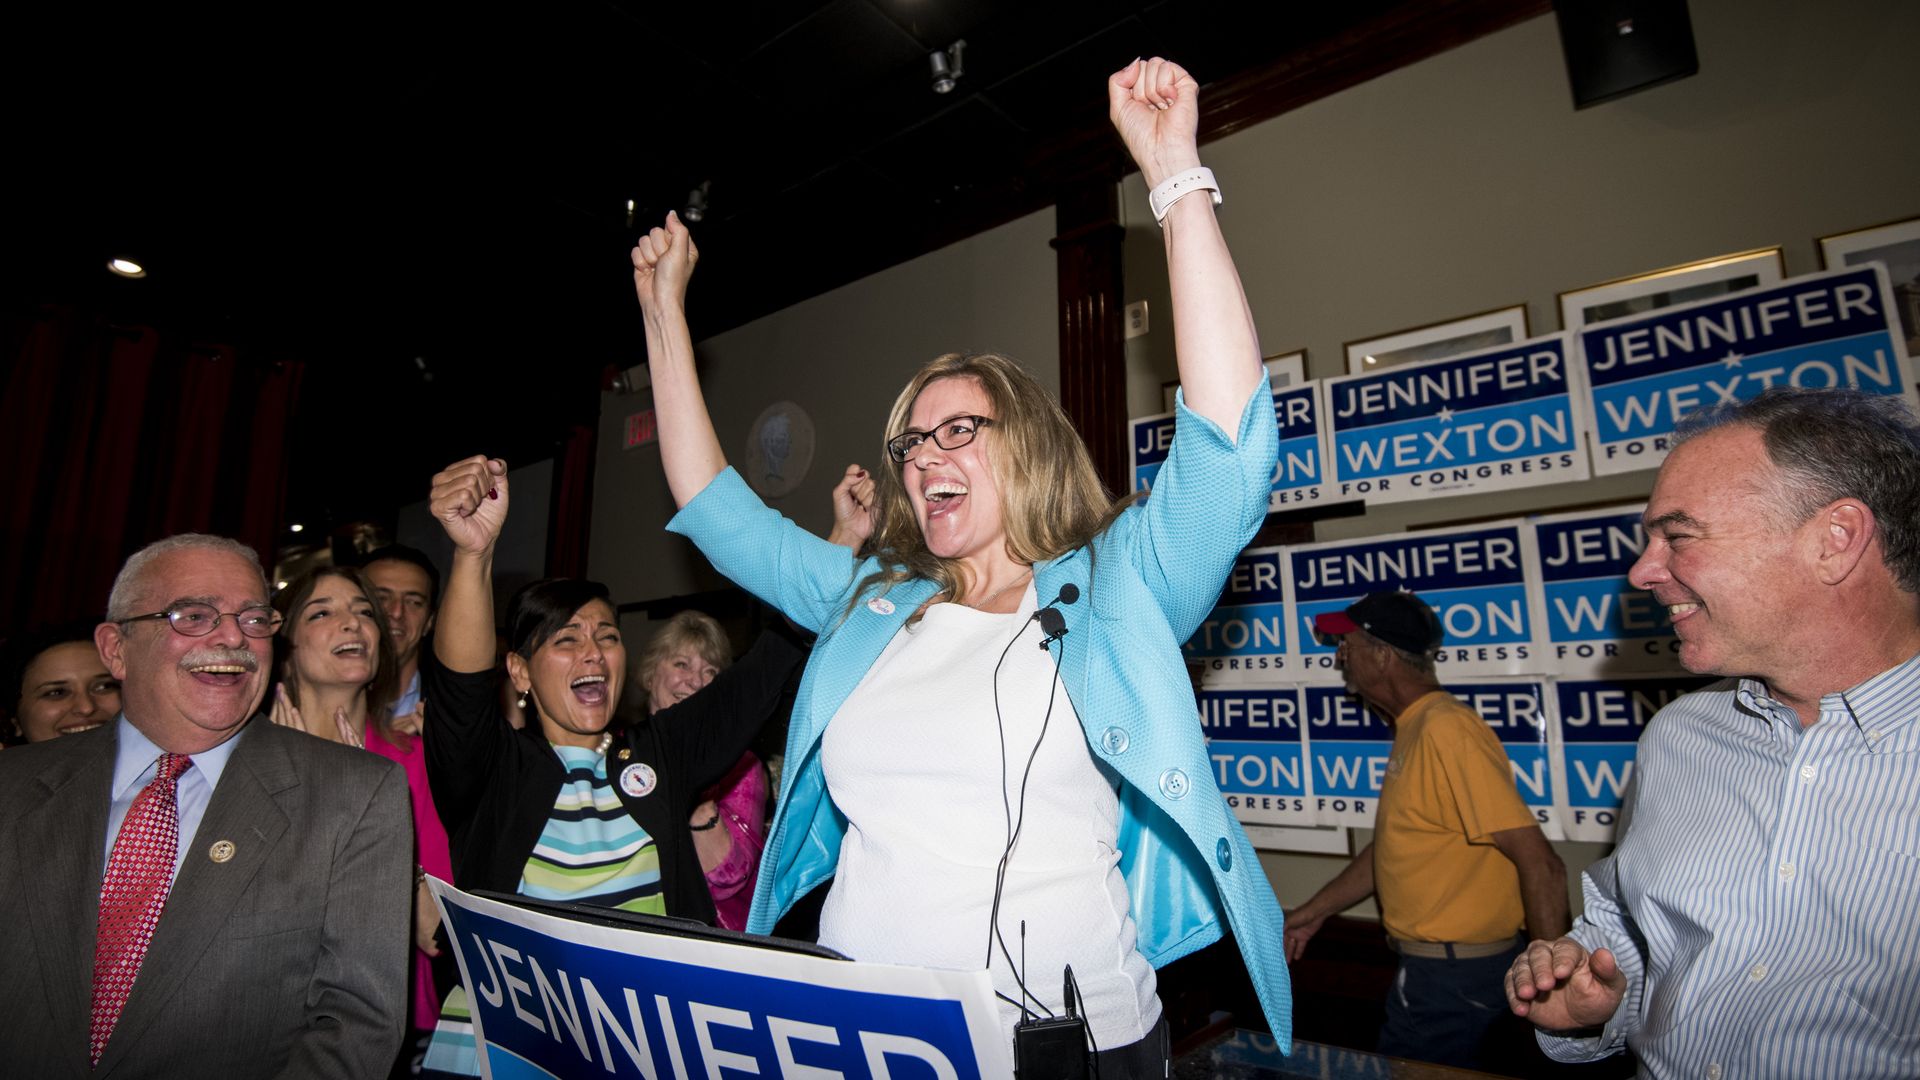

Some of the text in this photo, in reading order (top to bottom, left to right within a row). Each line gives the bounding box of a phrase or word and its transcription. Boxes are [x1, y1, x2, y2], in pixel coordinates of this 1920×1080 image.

[1593, 283, 1878, 370] JENNIFER
[1337, 350, 1561, 417] JENNIFER
[1342, 410, 1567, 472] WEXTON
[1606, 437, 1667, 459] FOR
[1341, 455, 1573, 495] FOR CONGRESS
[1298, 537, 1517, 589] JENNIFER
[1304, 646, 1529, 669] FO GRESS
[1557, 643, 1618, 659] FOR
[1211, 656, 1284, 670] GRESS
[1211, 754, 1299, 789] TON
[1227, 796, 1303, 811] GRESS
[1318, 799, 1365, 813] FOR
[1574, 810, 1615, 825] FO
